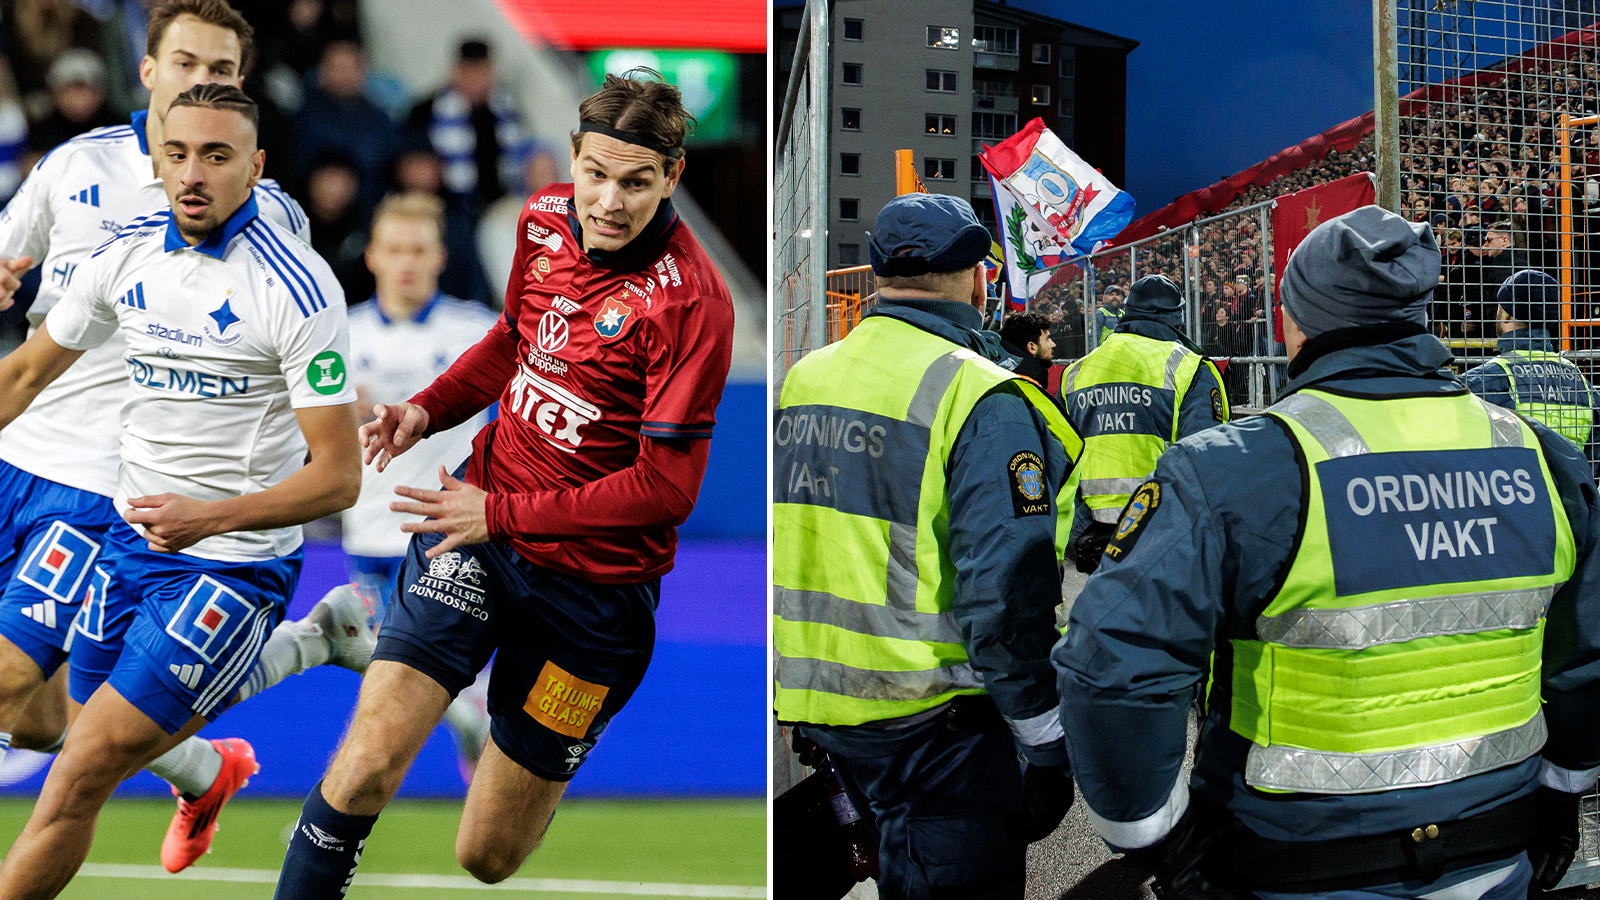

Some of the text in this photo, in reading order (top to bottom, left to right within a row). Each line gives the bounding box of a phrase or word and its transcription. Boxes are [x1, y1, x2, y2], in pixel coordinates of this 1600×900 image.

[529, 202, 568, 215] WELLNES
[538, 195, 568, 206] NORDIC
[624, 281, 647, 299] ERNST
[146, 323, 203, 348] stadium
[528, 352, 564, 376] gruppen
[1512, 363, 1582, 382] ORDNINGS
[1077, 386, 1152, 410] ORDNINGS
[1096, 412, 1136, 432] VAKT
[775, 413, 887, 459] ODNINGS
[1346, 468, 1536, 517] ORDNINGS
[1022, 503, 1049, 514] VAKT
[1403, 516, 1498, 562] VAKT
[418, 575, 486, 606] STIFTELSEN
[544, 674, 601, 713] TRIUMF
[539, 695, 589, 728] GLASS
